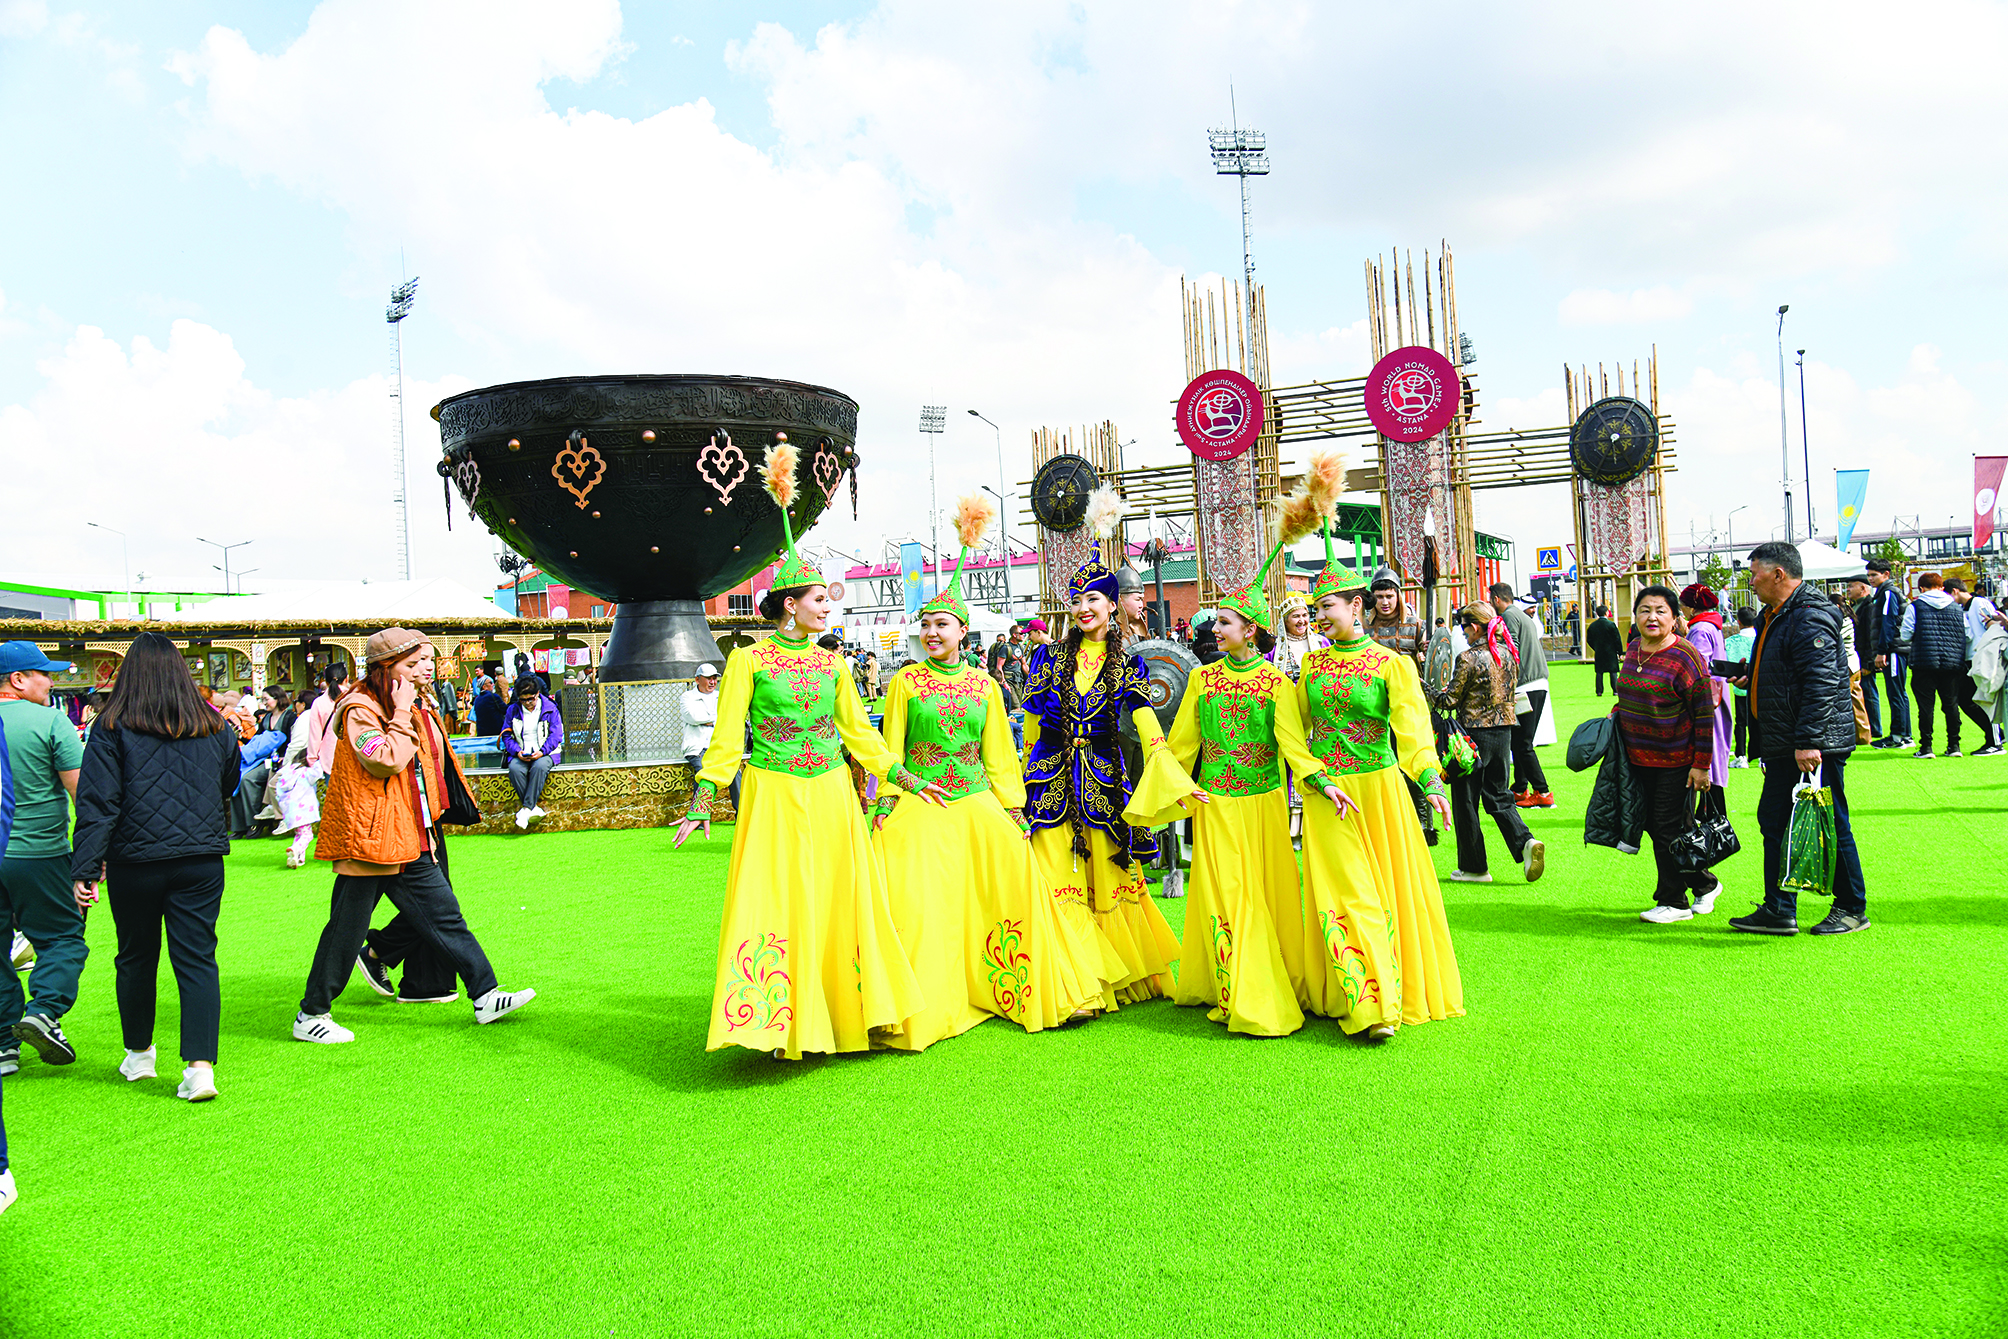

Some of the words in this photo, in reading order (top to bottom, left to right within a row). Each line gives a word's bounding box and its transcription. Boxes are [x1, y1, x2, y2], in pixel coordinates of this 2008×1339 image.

[1204, 379, 1248, 398] КӨШПЕНДІЛЕР
[1381, 366, 1402, 395] WORLD
[1404, 361, 1435, 376] NOMAD
[1434, 377, 1443, 409] GAMES
[1396, 414, 1429, 424] ASTANA
[1402, 426, 1424, 434] 2024
[1208, 438, 1236, 447] АСТАНА
